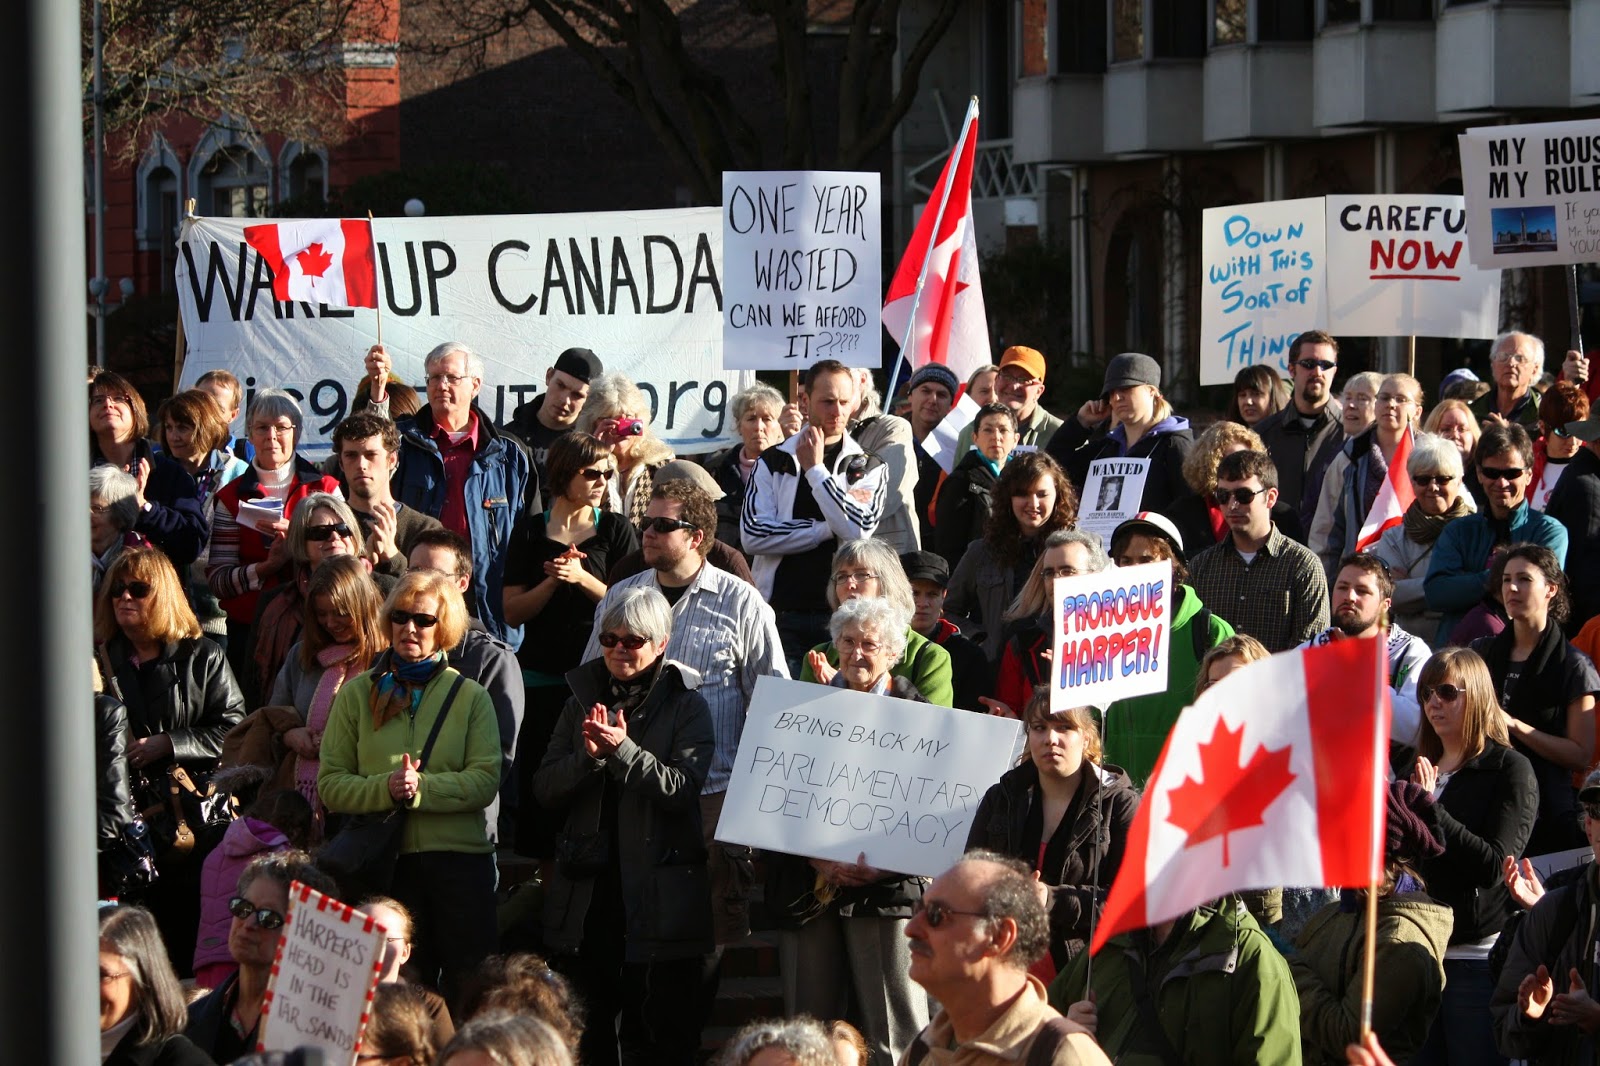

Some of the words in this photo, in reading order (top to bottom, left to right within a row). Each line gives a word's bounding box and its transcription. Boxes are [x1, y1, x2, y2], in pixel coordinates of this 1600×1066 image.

[1488, 138, 1526, 167] MY
[1488, 171, 1529, 199] MY
[729, 182, 799, 235] ONE
[812, 184, 868, 241] YEAR
[1340, 204, 1467, 235] CAREFU
[376, 240, 457, 317] UP
[487, 232, 723, 316] CANADA
[754, 248, 858, 293] WASTED
[1370, 238, 1463, 270] NOW
[730, 303, 772, 329] CAN
[782, 302, 806, 328] WE
[815, 305, 867, 328] AFFORD
[1092, 462, 1144, 477] WANTED
[1063, 579, 1164, 636] PROROGUE
[1060, 623, 1163, 690] HARPER!
[773, 711, 842, 738] BRING
[848, 725, 910, 752] BACK
[912, 736, 950, 759] MY
[758, 784, 963, 848] DEMOCRACY
[294, 906, 369, 966] HARPER'S
[287, 943, 325, 976] HEAD
[334, 967, 352, 990] IS
[277, 993, 303, 1033] TAR
[289, 974, 304, 995] IN
[307, 983, 341, 1011] THE
